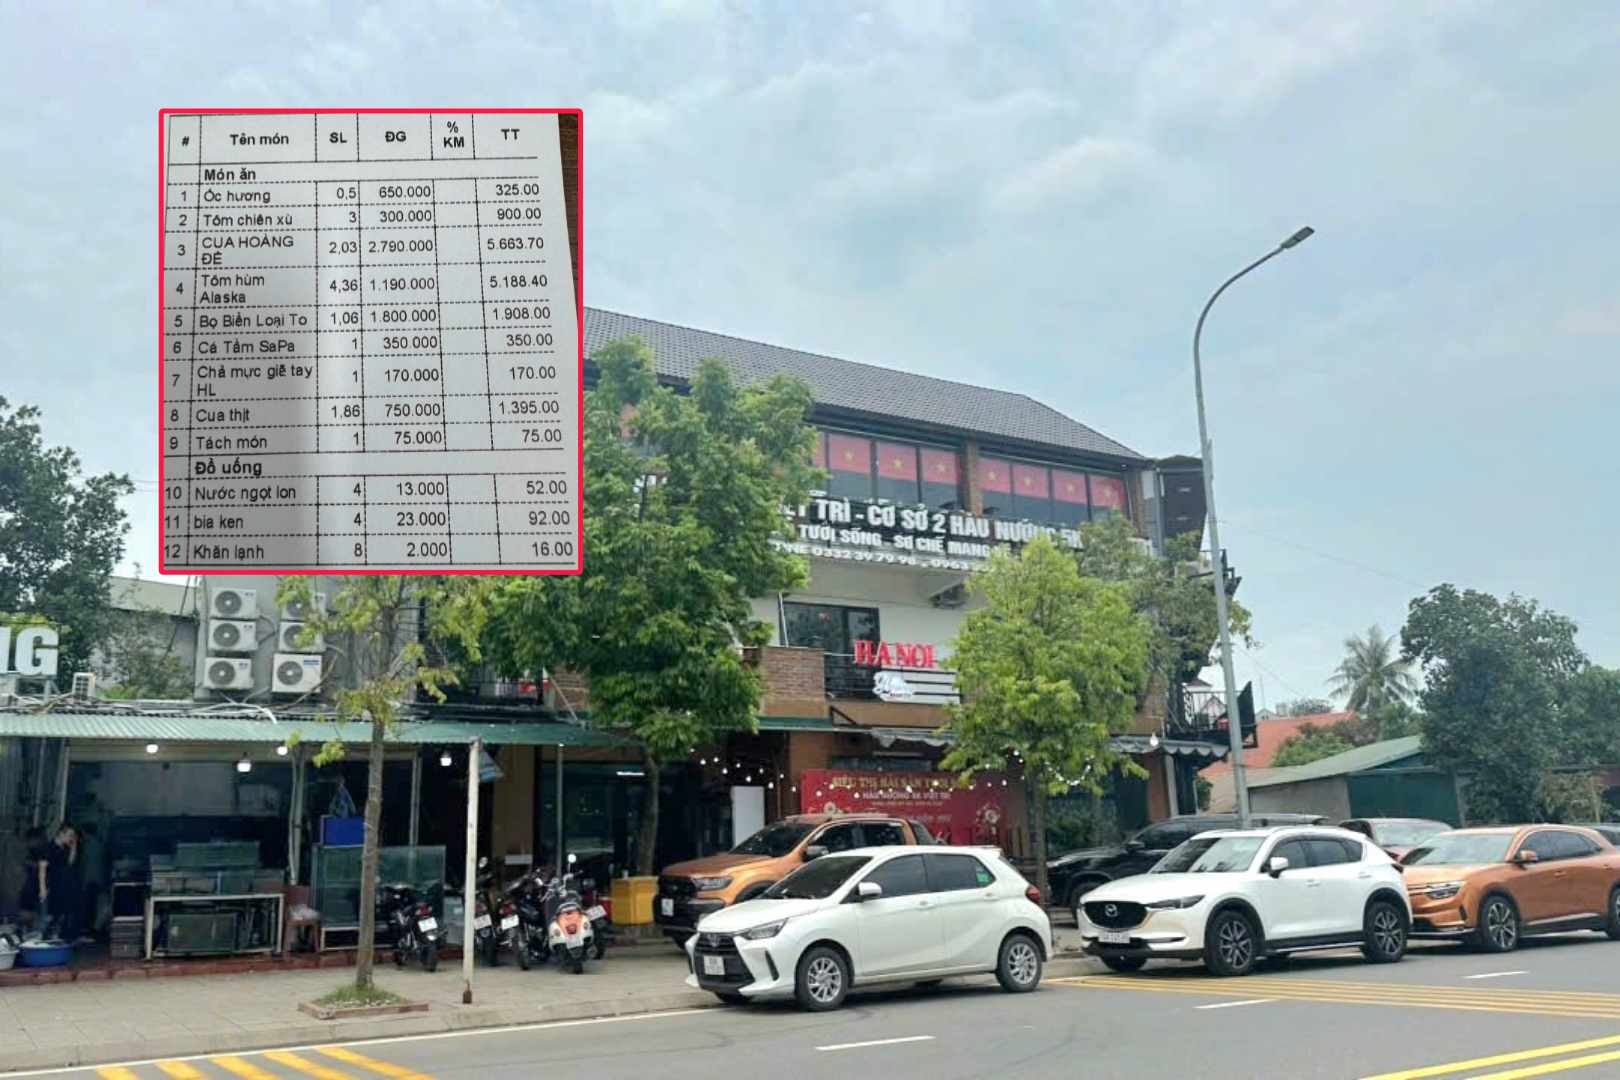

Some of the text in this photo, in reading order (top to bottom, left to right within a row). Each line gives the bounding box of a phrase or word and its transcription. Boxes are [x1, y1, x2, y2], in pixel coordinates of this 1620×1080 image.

[816, 497, 851, 523] TRÌ
[867, 505, 896, 527] CƠ
[900, 503, 928, 531] SỞ
[932, 513, 946, 533] 2
[840, 527, 882, 546] SỐNG
[894, 535, 913, 550] SƠ
[915, 536, 944, 552] CHẾ
[947, 541, 990, 557] MANG
